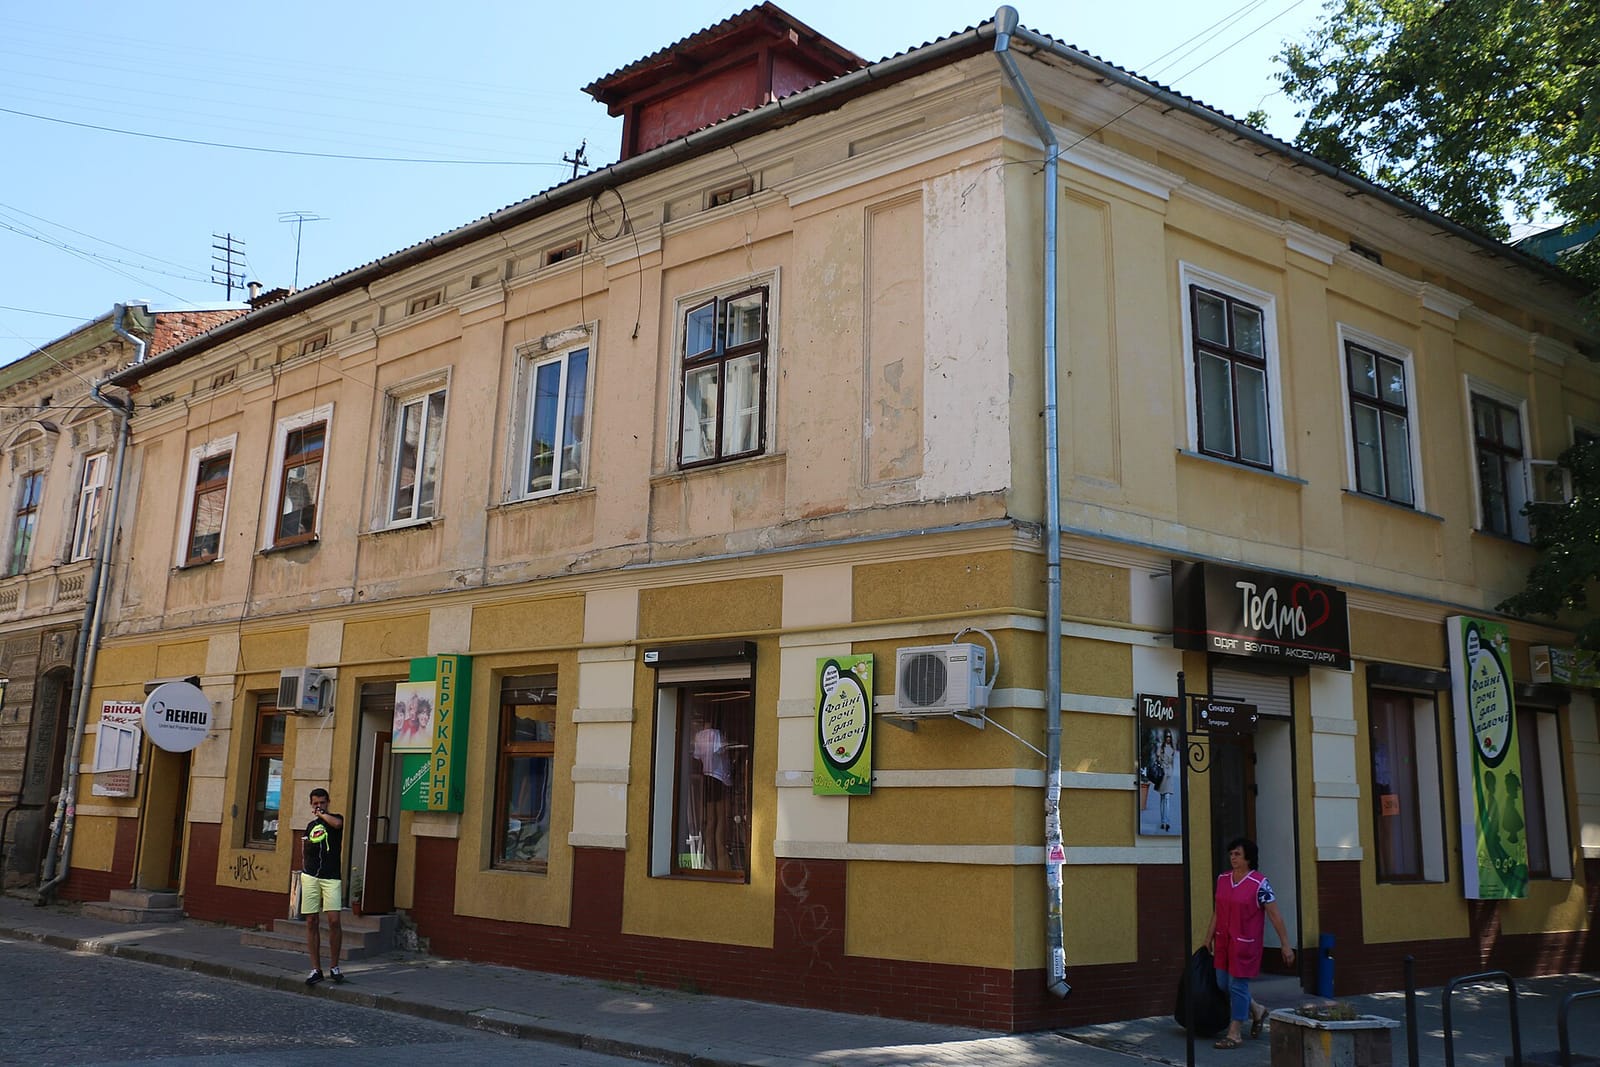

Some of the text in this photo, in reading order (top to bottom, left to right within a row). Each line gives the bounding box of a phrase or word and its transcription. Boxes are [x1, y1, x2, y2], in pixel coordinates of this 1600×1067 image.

[1213, 636, 1336, 663] ОДЯГ ВЗУТТЯ АКСЕСУАРИ
[103, 705, 142, 714] ВІКНА
[825, 693, 862, 713] Файні
[1208, 703, 1235, 713] Синагога
[165, 708, 207, 725] REHAU
[433, 660, 453, 805] ПЕРУКАРНЯ
